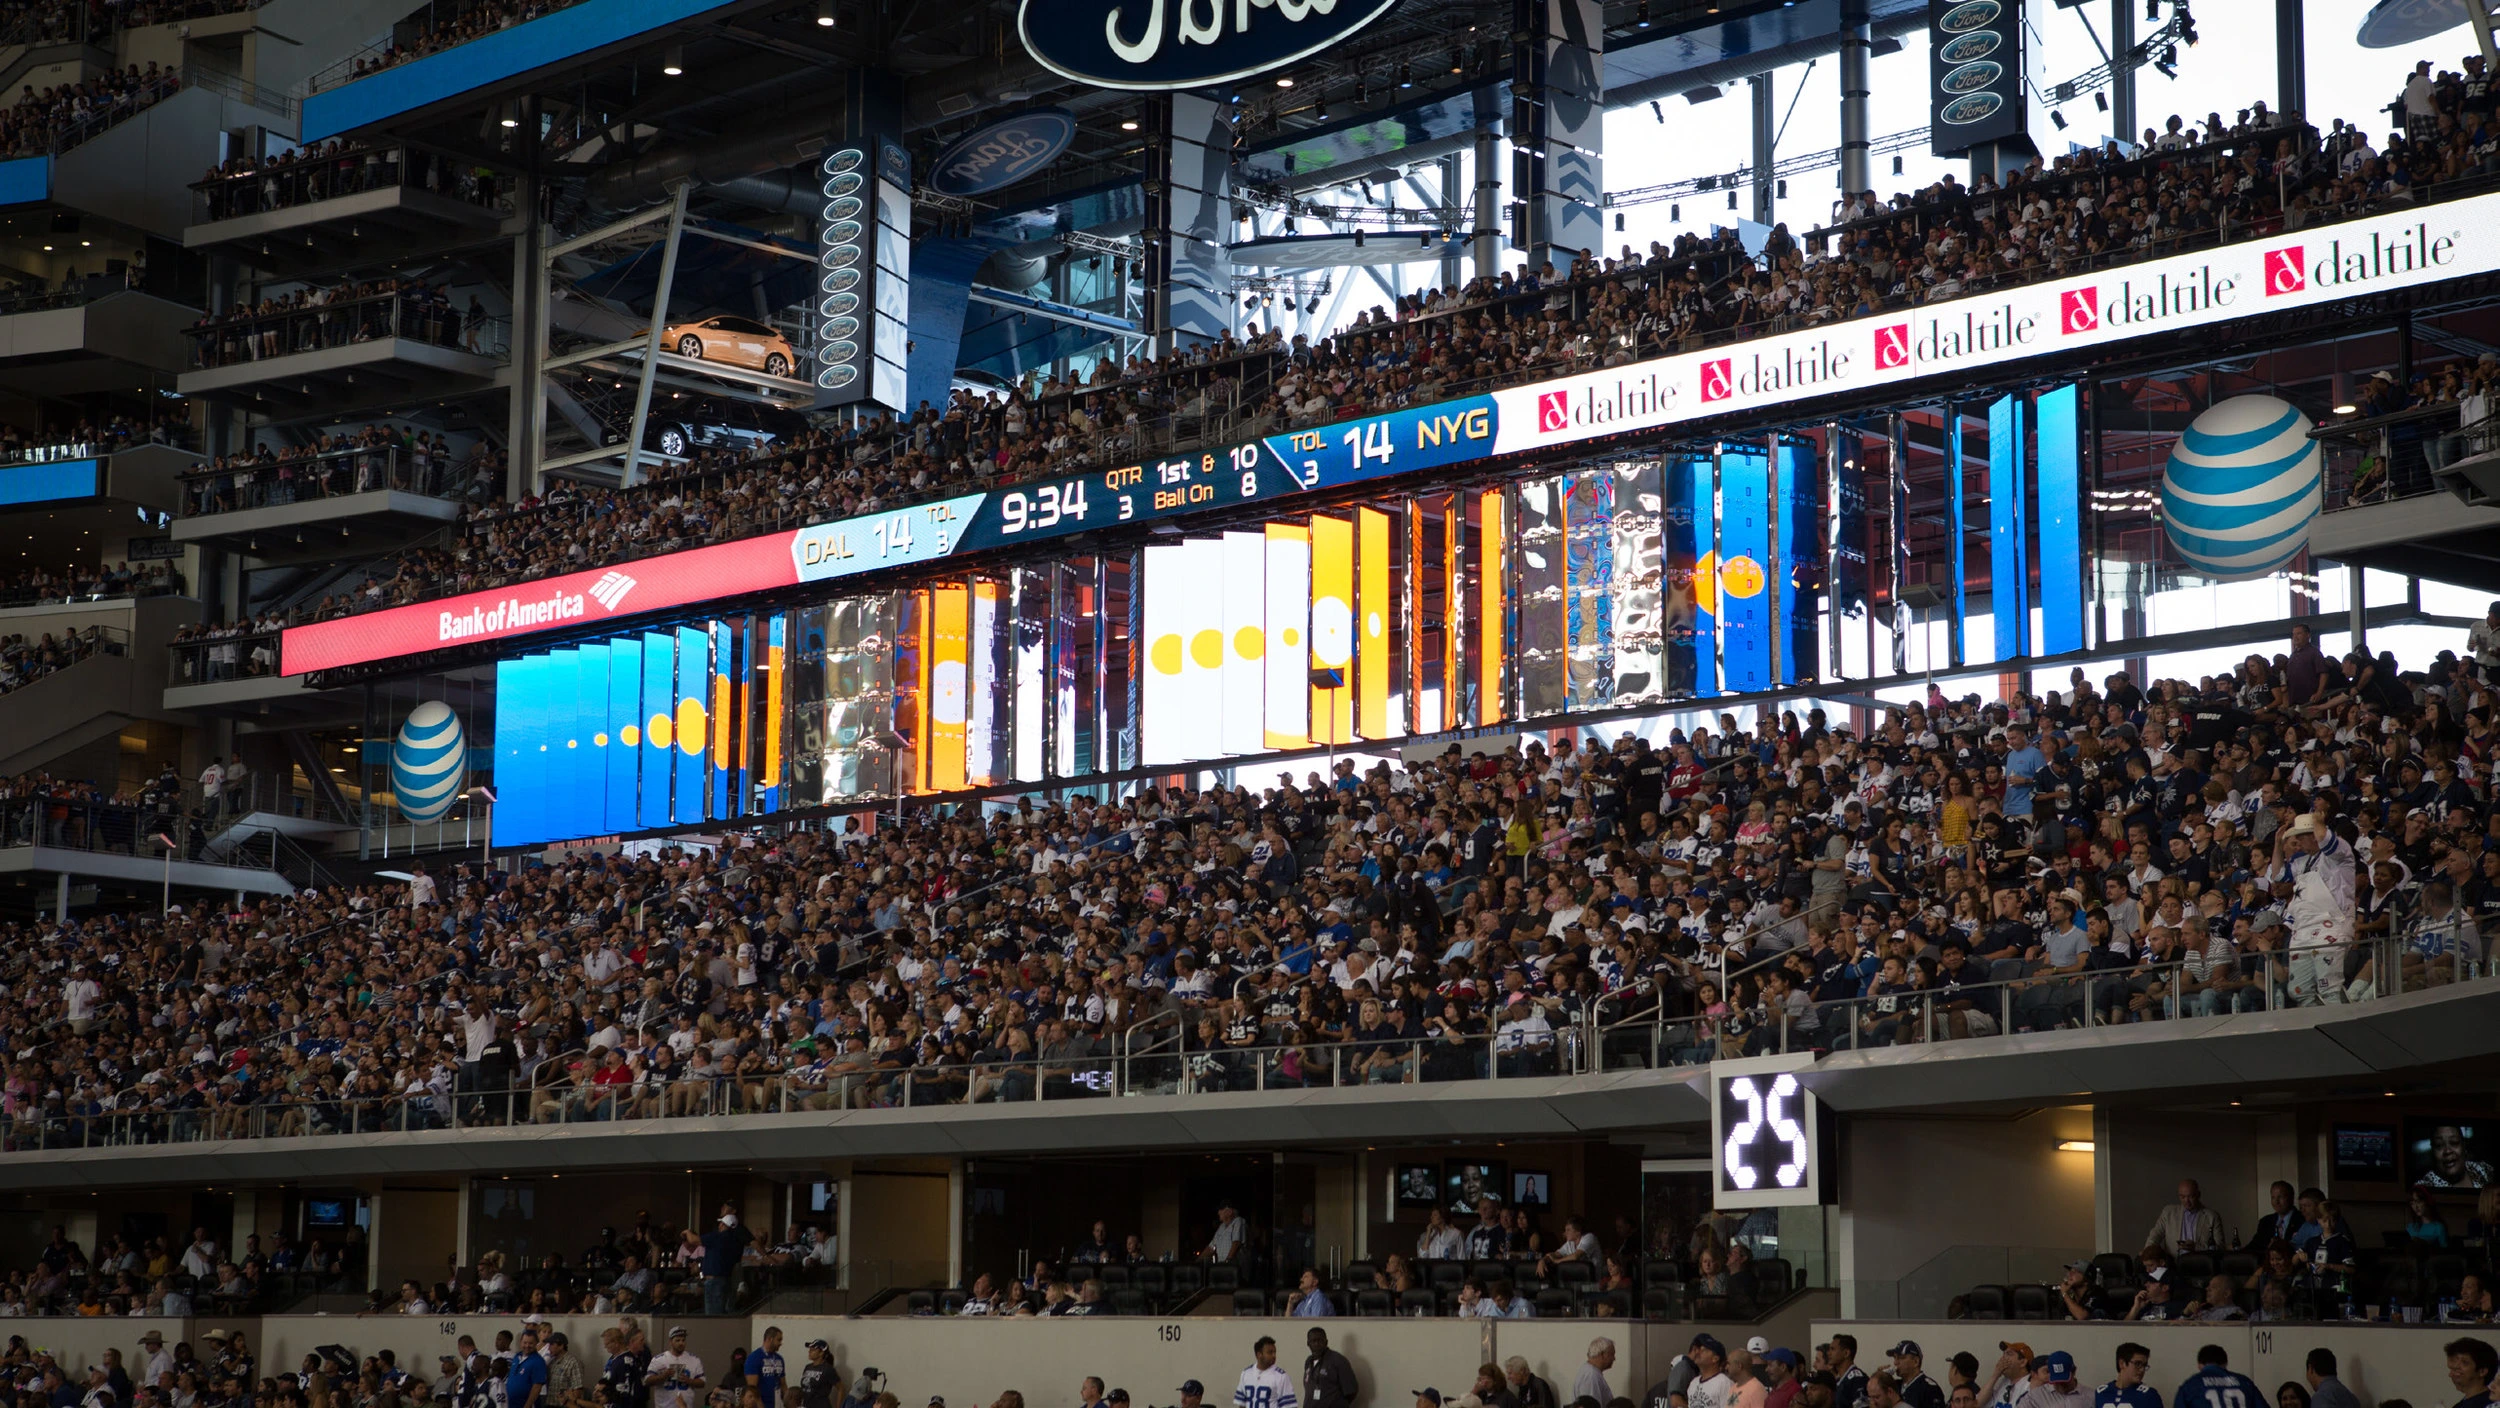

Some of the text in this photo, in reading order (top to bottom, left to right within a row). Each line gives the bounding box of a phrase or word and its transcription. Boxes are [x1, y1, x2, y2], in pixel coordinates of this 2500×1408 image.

[1954, 7, 1989, 28] Ford
[1954, 37, 1989, 59] Ford
[1955, 68, 1990, 89] Ford
[1956, 99, 1990, 120] Ford
[946, 129, 1050, 183] Ford
[1275, 242, 1445, 264] Ford
[2314, 223, 2455, 287] daltile
[2107, 265, 2236, 326] daltile
[1917, 304, 2035, 363] daltile
[1740, 343, 1850, 396] daltile
[1575, 373, 1678, 427] daltile
[1289, 431, 1327, 453] TOL
[1344, 407, 1489, 469] 14 NYG
[1157, 444, 1258, 486] 1st & 10
[1304, 460, 1319, 485] 3
[1105, 466, 1142, 491] QTR
[1154, 472, 1257, 510] Ball On 8
[927, 504, 957, 523] TOL
[1001, 480, 1088, 534] 9:34
[1118, 495, 1133, 520] 3
[804, 514, 913, 565] DAL 14
[936, 530, 950, 554] 3
[439, 590, 584, 641] Bank of America
[1724, 1074, 1807, 1189] 25
[440, 1322, 456, 1336] 149
[1158, 1325, 1181, 1342] 150
[2256, 1331, 2273, 1354] 101
